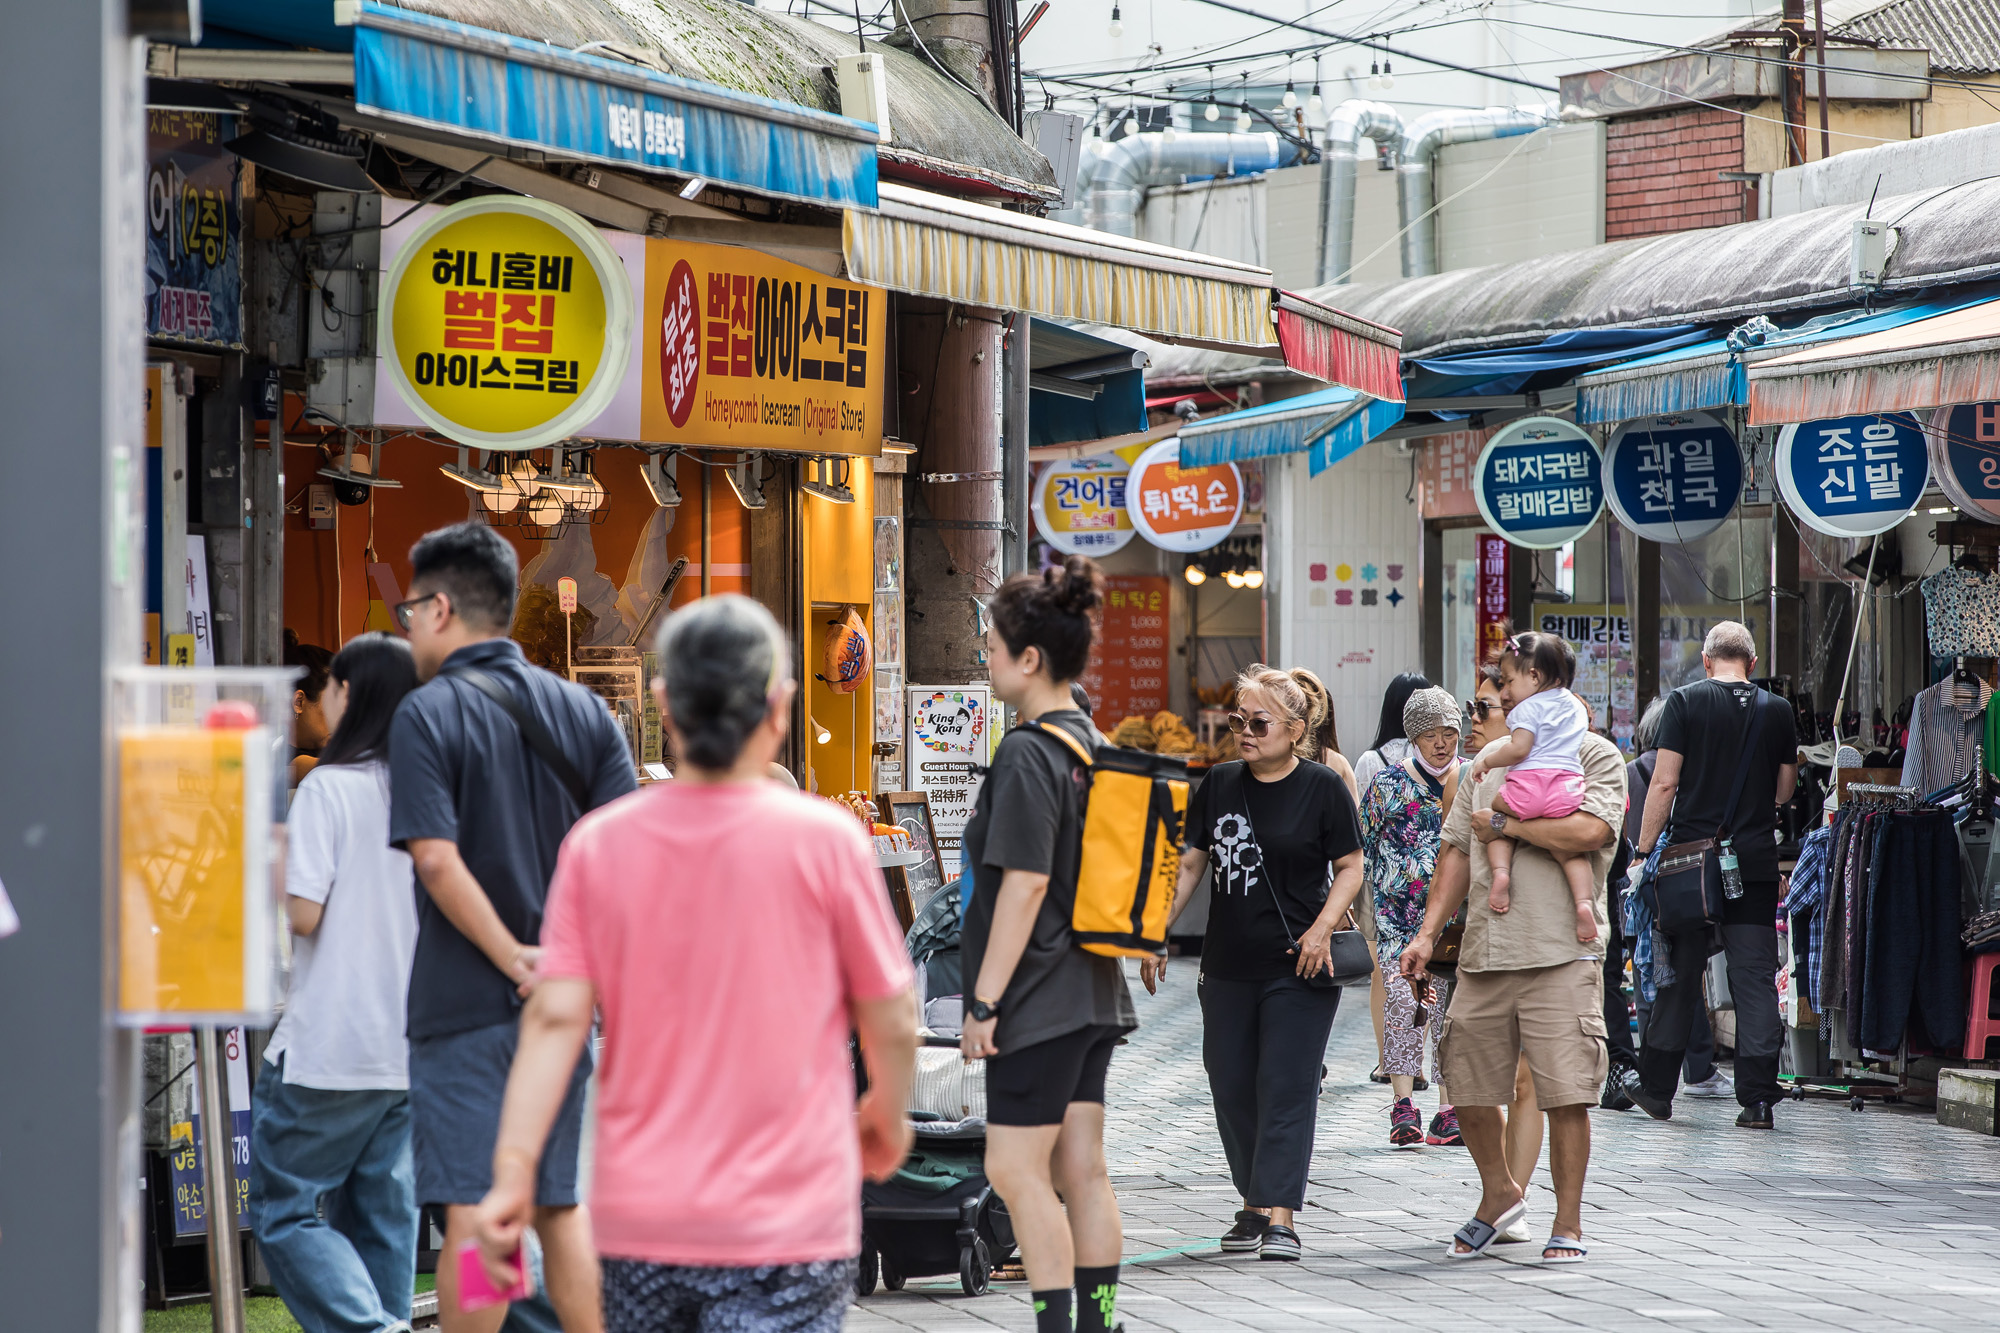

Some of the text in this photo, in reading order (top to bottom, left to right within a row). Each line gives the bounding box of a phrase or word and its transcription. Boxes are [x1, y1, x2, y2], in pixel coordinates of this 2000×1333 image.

[432, 249, 573, 292] 허니홈비
[444, 290, 555, 354] 벌집
[664, 273, 692, 357] 부산
[415, 352, 578, 394] 아이스크림
[669, 327, 698, 415] 최초
[705, 390, 866, 438] Honeycomb Icecream (Original Store)
[1638, 439, 1715, 474] 과일
[1818, 423, 1899, 463] 조은
[1494, 451, 1591, 484] 돼지국밥
[1819, 462, 1903, 504] 신발
[1055, 476, 1127, 509] 건어물
[1496, 487, 1593, 520] 할매김밥
[1640, 476, 1718, 512] 천국
[928, 714, 955, 725] King
[935, 724, 962, 735] Kong
[921, 775, 977, 785] 게스트하우스
[930, 789, 968, 803] 招待所
[931, 808, 976, 818] ストハウ
